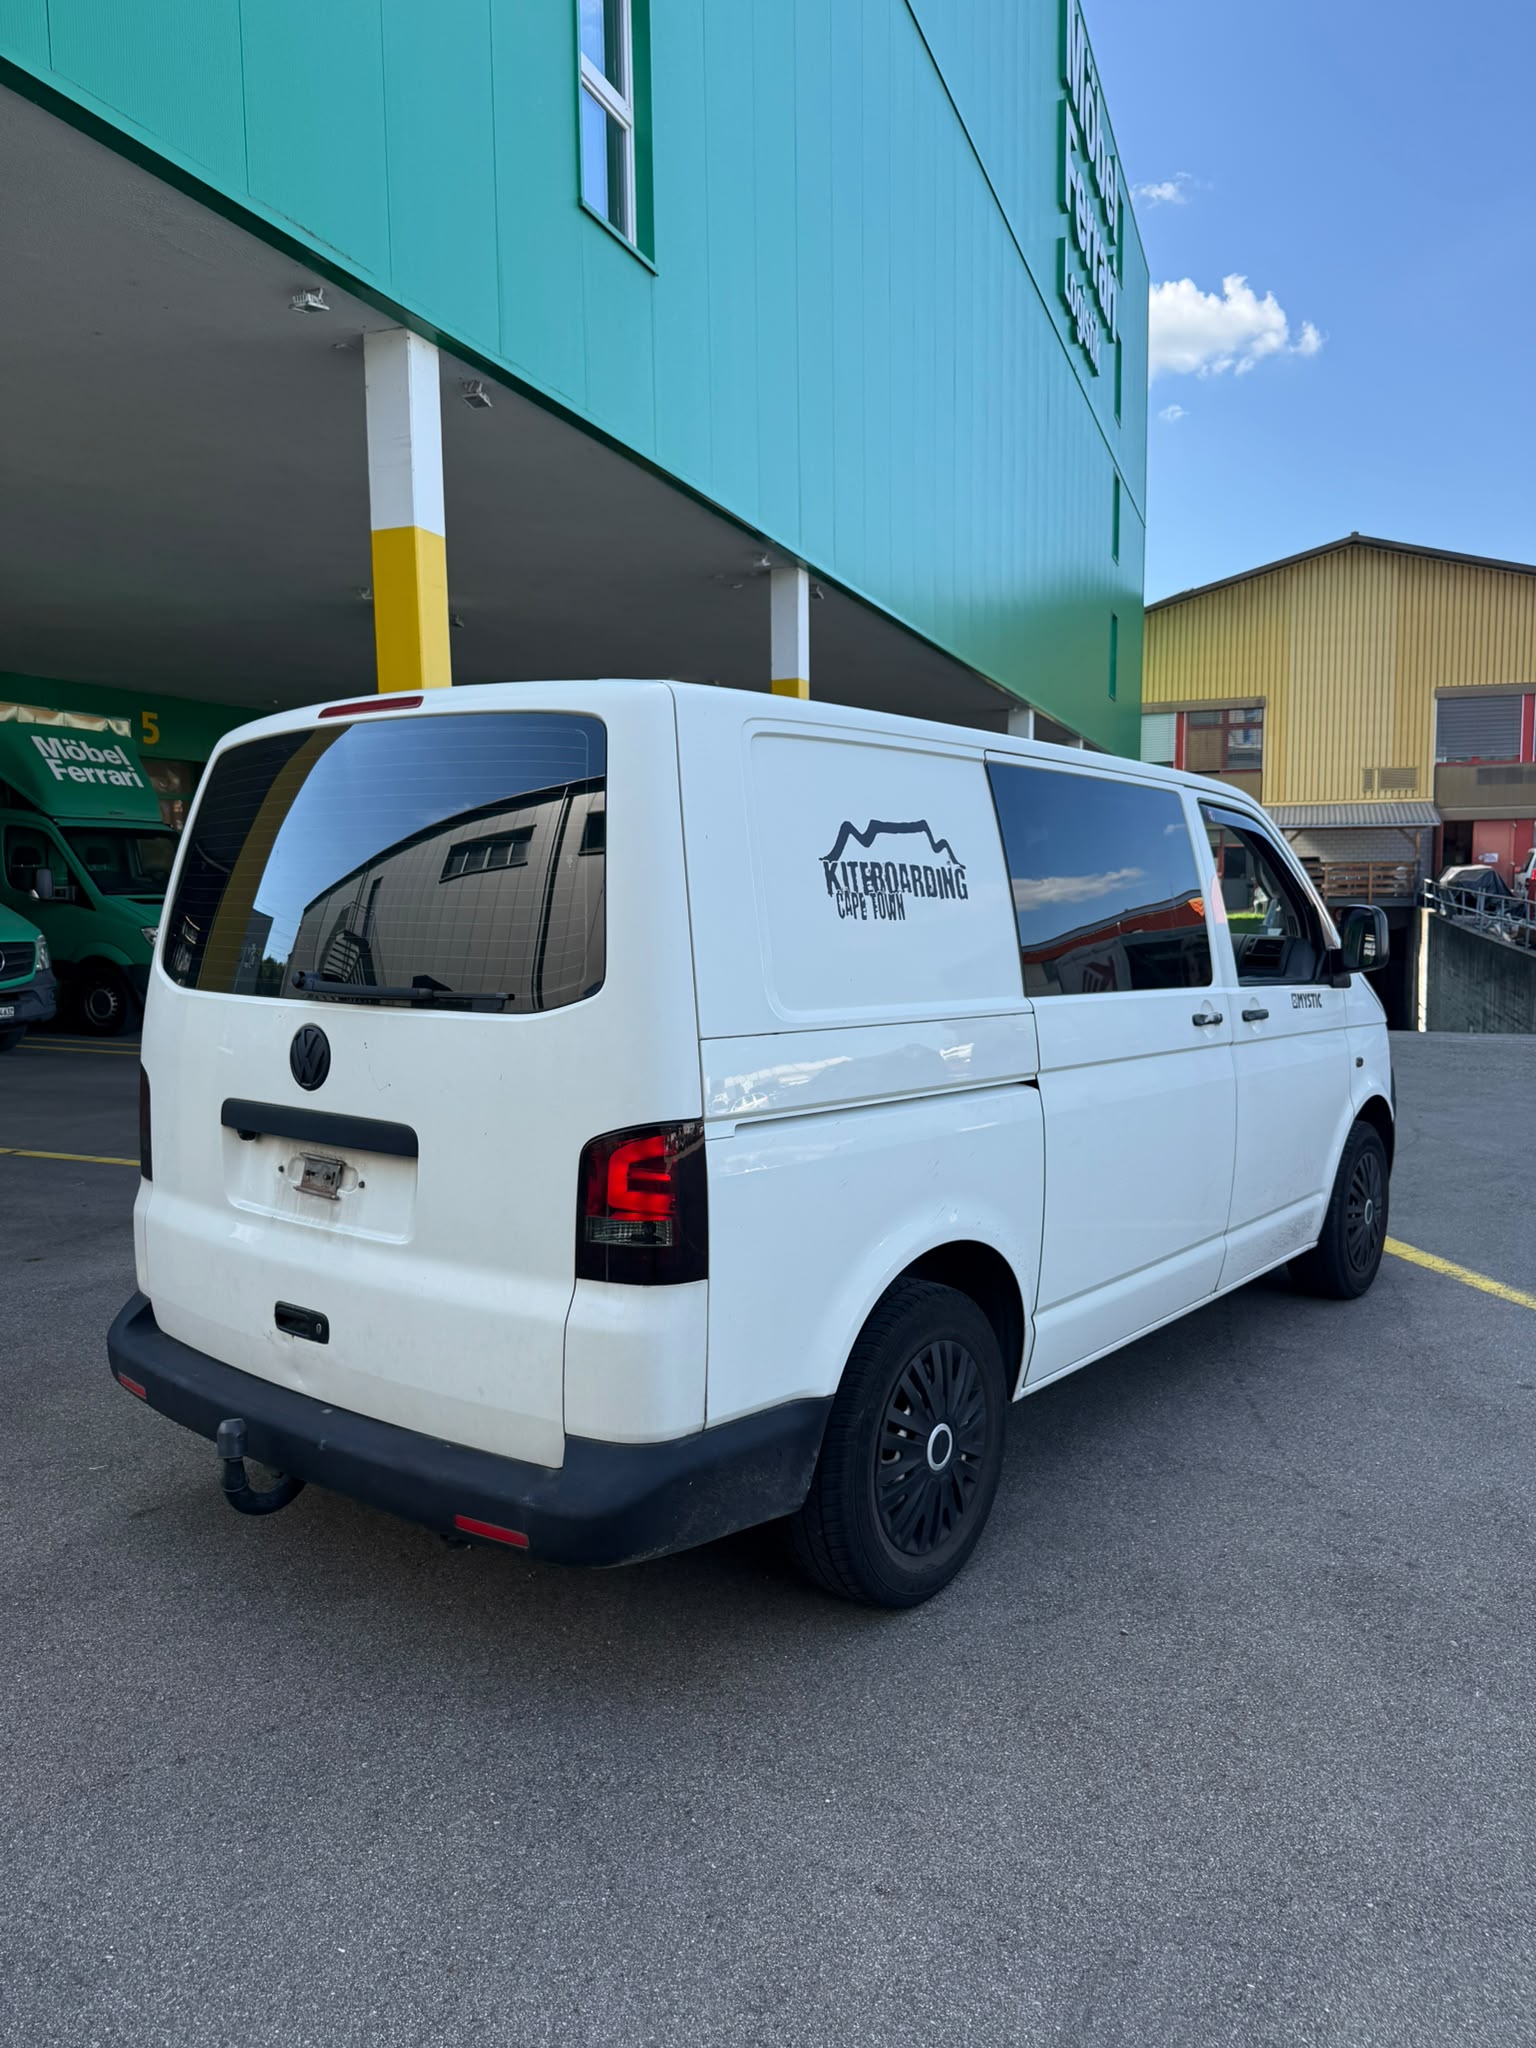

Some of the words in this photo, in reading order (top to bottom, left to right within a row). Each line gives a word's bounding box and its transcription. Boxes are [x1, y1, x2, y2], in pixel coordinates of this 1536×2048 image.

[1066, 0, 1118, 245] Möbel
[1065, 100, 1117, 343] Ferrari
[142, 711, 159, 744] 5
[31, 735, 131, 765] Möbel
[45, 759, 144, 788] Ferrari
[823, 861, 969, 900] KITEBOARDING
[836, 890, 867, 921] CAPE
[870, 891, 906, 921] TOWN
